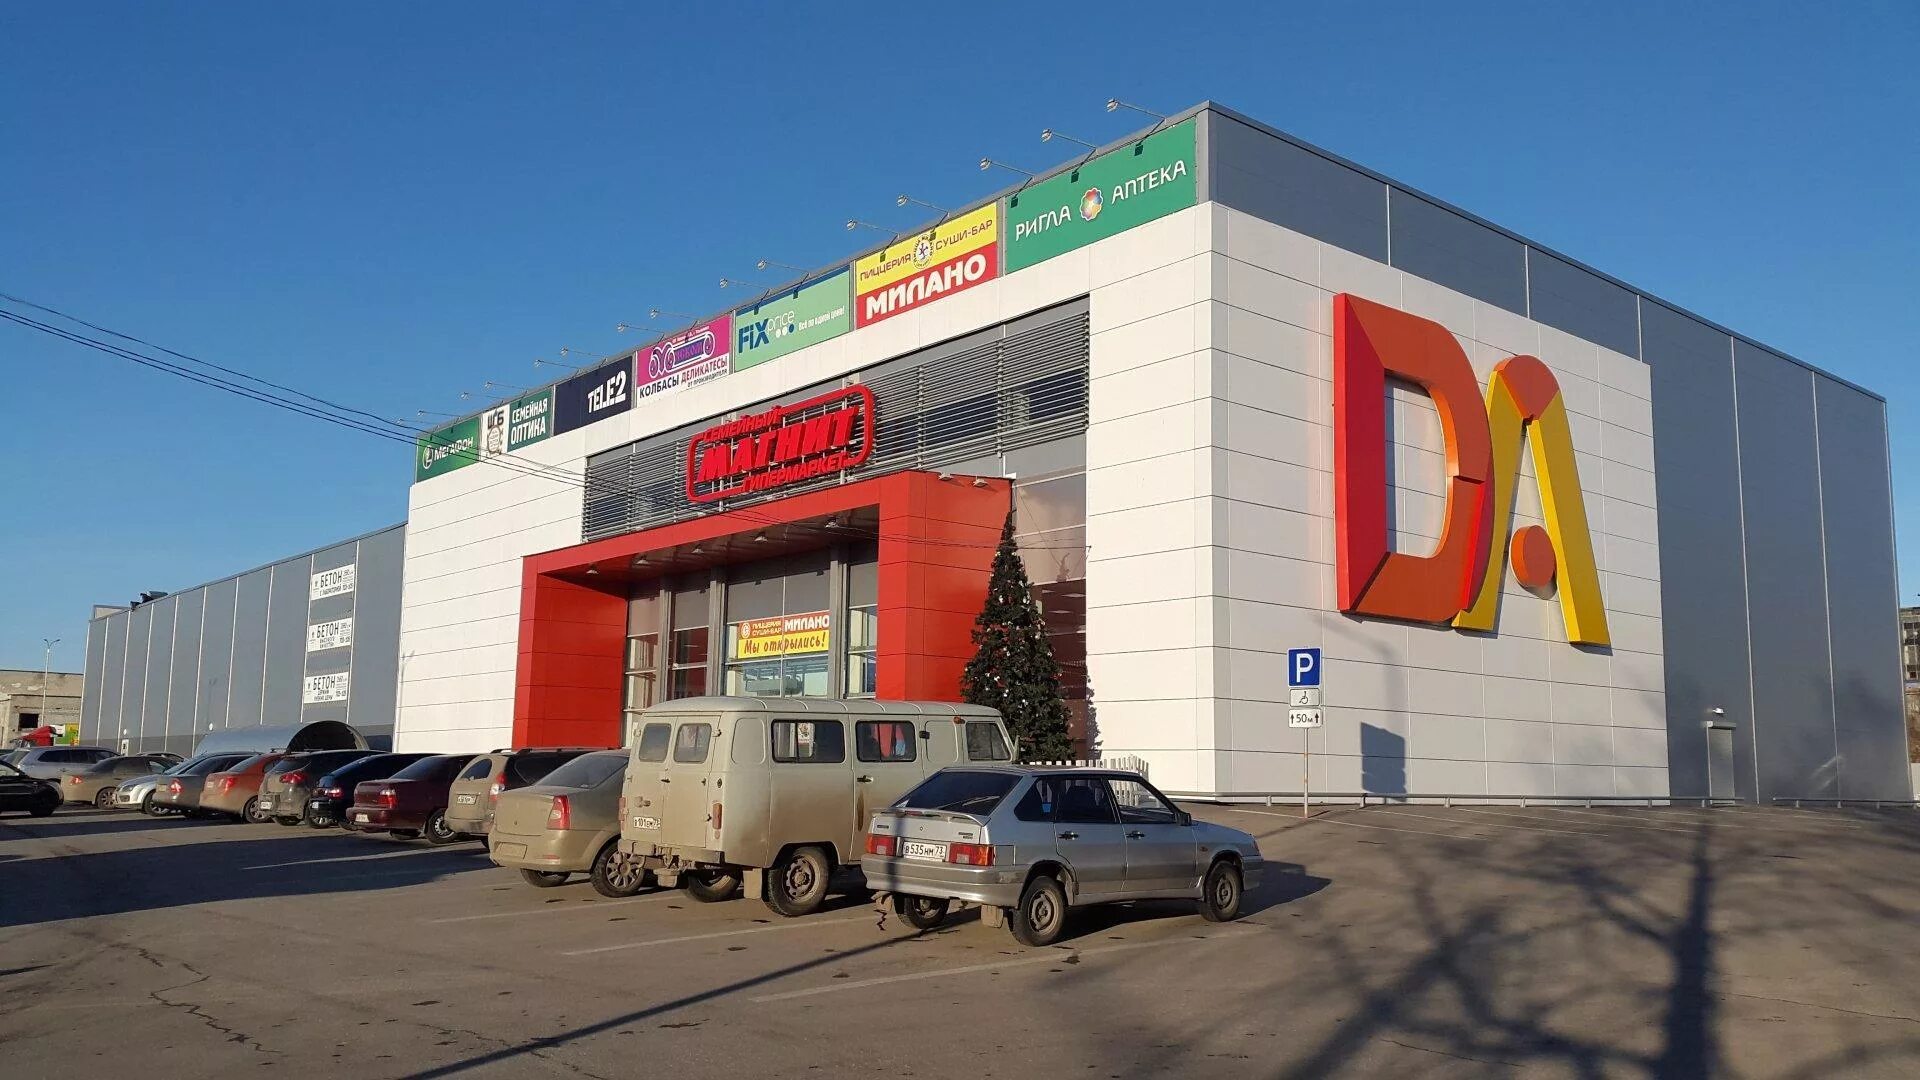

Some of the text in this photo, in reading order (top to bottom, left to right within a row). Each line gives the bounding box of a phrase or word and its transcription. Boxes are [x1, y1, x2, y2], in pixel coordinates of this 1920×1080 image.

[1015, 159, 1188, 242] РИГЛА АПТЕКА
[859, 219, 993, 282] ПИЦЦЕРИЯ СУШИ-БАР
[866, 253, 987, 321] МИЛАНО
[587, 370, 627, 414] TELE2
[639, 355, 728, 400] КОЛБАСЫ ДЕЛИКАТЕСЫ
[511, 397, 548, 424] СЕМЕЙНАЯ
[702, 405, 782, 442] СЕМЕЙНЫЙ
[510, 416, 546, 445] ОПТИКА
[697, 404, 861, 484] МАГНИТ
[741, 449, 850, 493] ГИПЕРМАРКЕТ
[321, 570, 342, 588] БЕТОН
[317, 622, 339, 638] БЕТОН
[784, 614, 830, 633] МИЛАНО
[744, 631, 826, 655] Мы открылись!
[313, 675, 335, 690] БЕТОН
[1296, 653, 1314, 683] P
